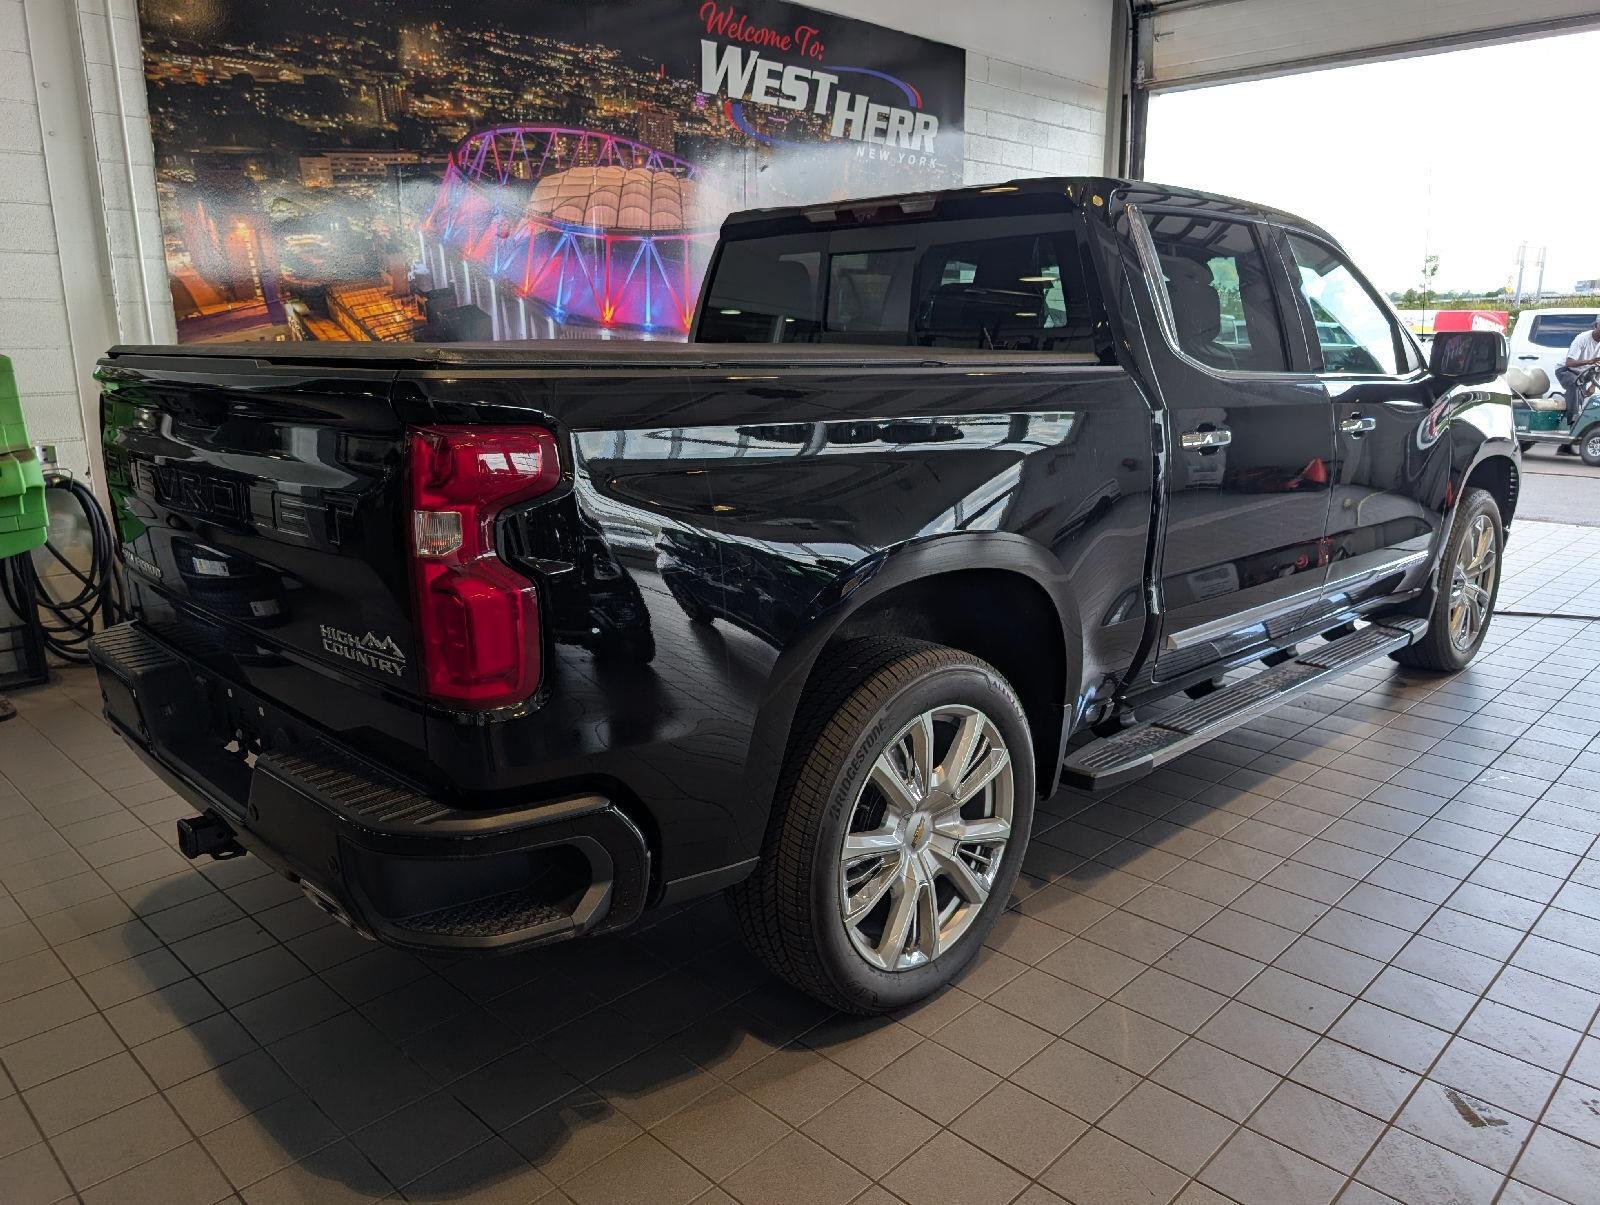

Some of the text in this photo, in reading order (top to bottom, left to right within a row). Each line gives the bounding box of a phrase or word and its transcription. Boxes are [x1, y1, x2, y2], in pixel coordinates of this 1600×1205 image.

[698, 1, 825, 61] Welcome To:
[700, 39, 939, 154] WEST HERR
[856, 146, 938, 168] NEW YORK
[319, 624, 361, 647] HIGH
[322, 638, 406, 677] COUNTRY
[829, 718, 887, 821] BRIDGESTONE
